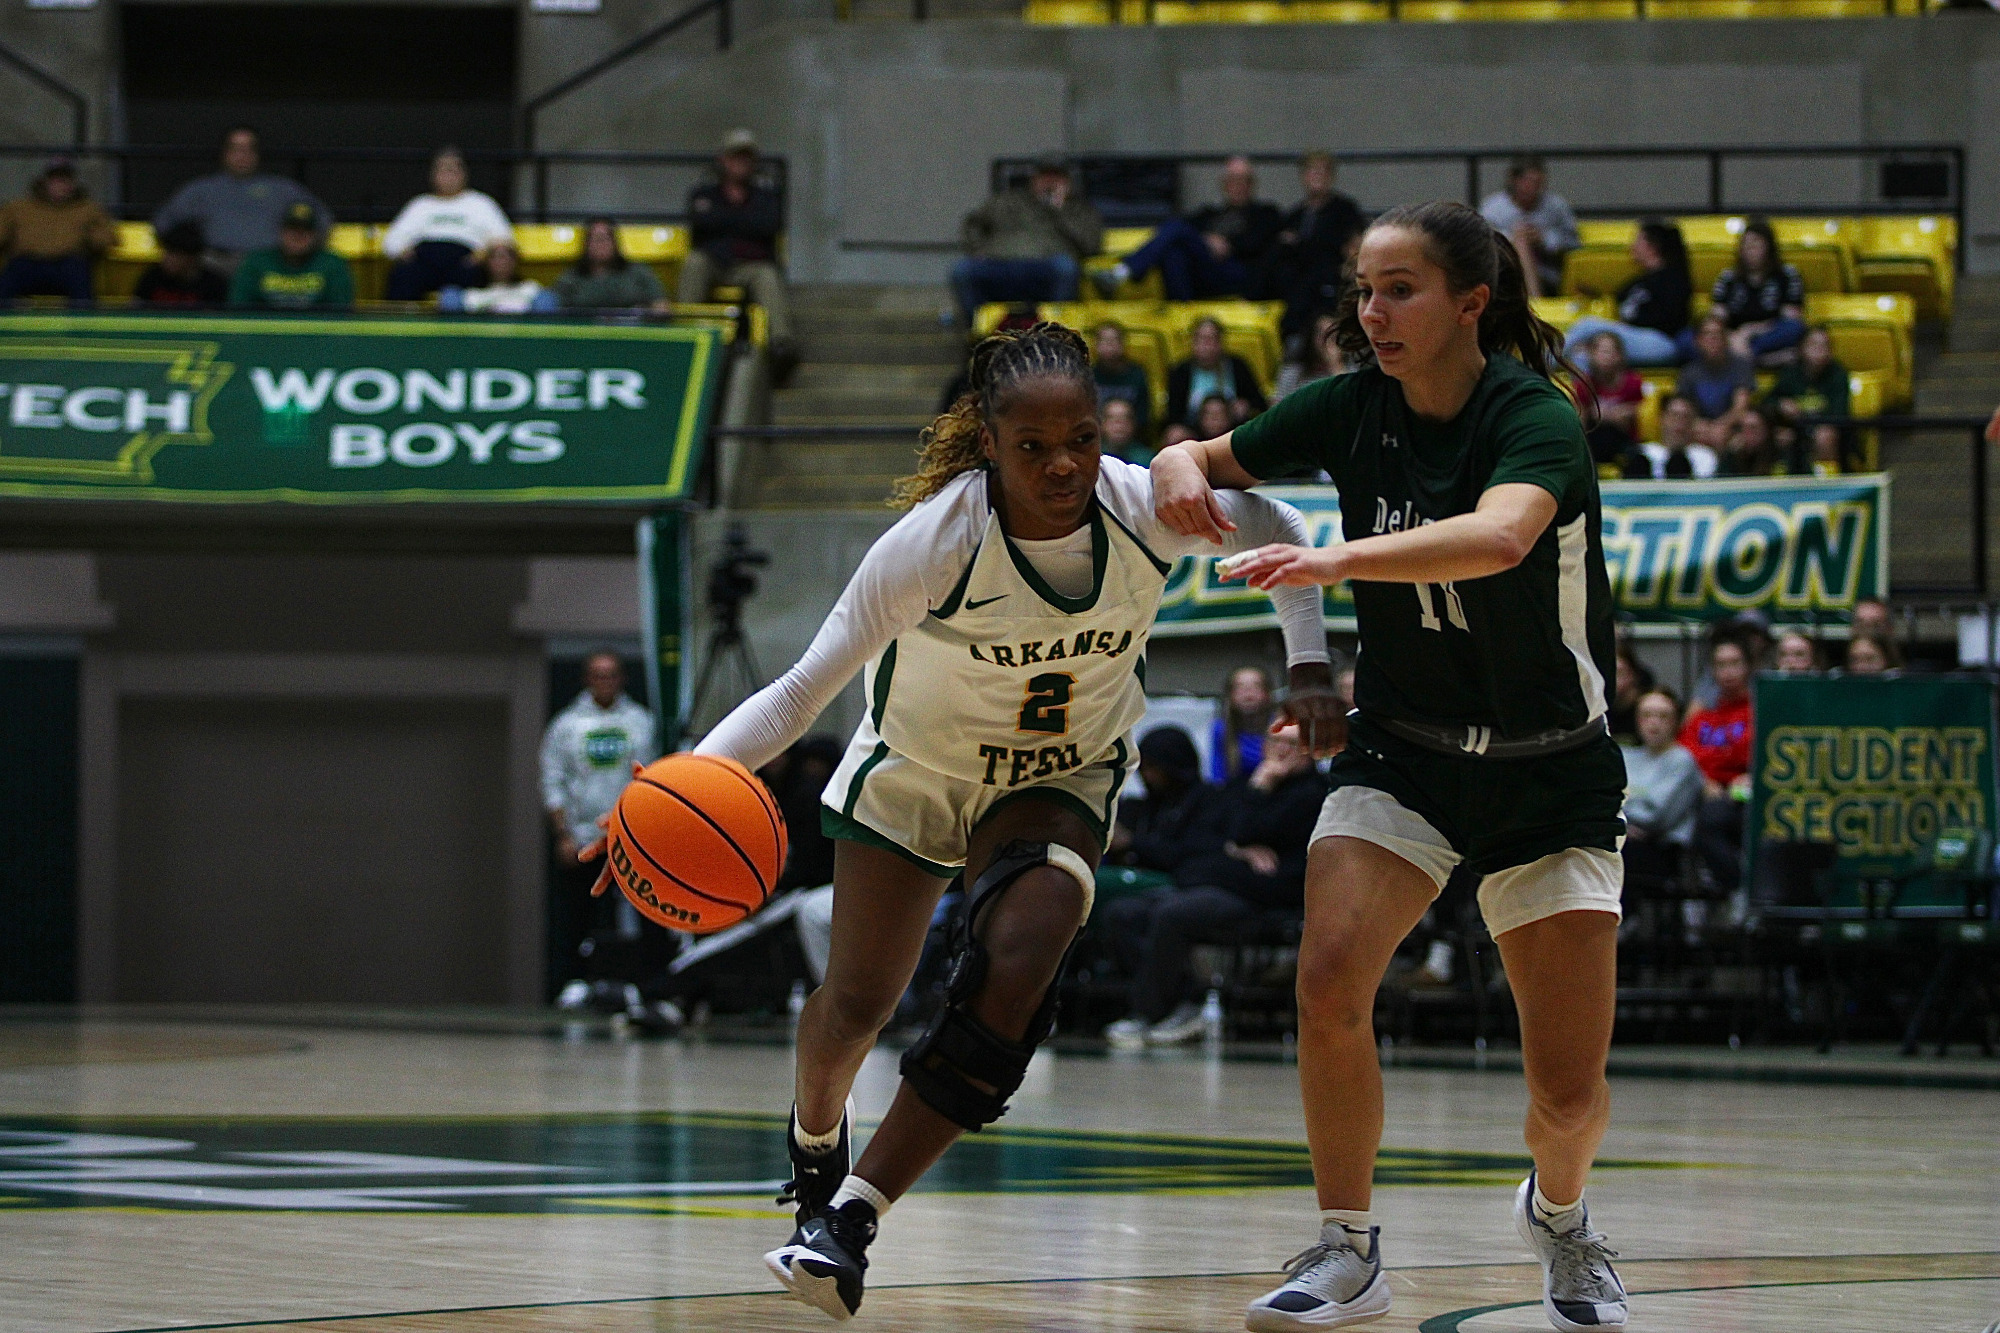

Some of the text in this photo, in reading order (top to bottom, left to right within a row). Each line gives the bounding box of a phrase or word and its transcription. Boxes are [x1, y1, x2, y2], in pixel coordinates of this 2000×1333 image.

[0, 384, 191, 432] ECH
[249, 367, 647, 414] WONDER
[329, 420, 566, 468] BOYS
[1015, 671, 1079, 737] 2
[1764, 726, 1986, 788] STUDENT
[612, 834, 700, 925] Wilson
